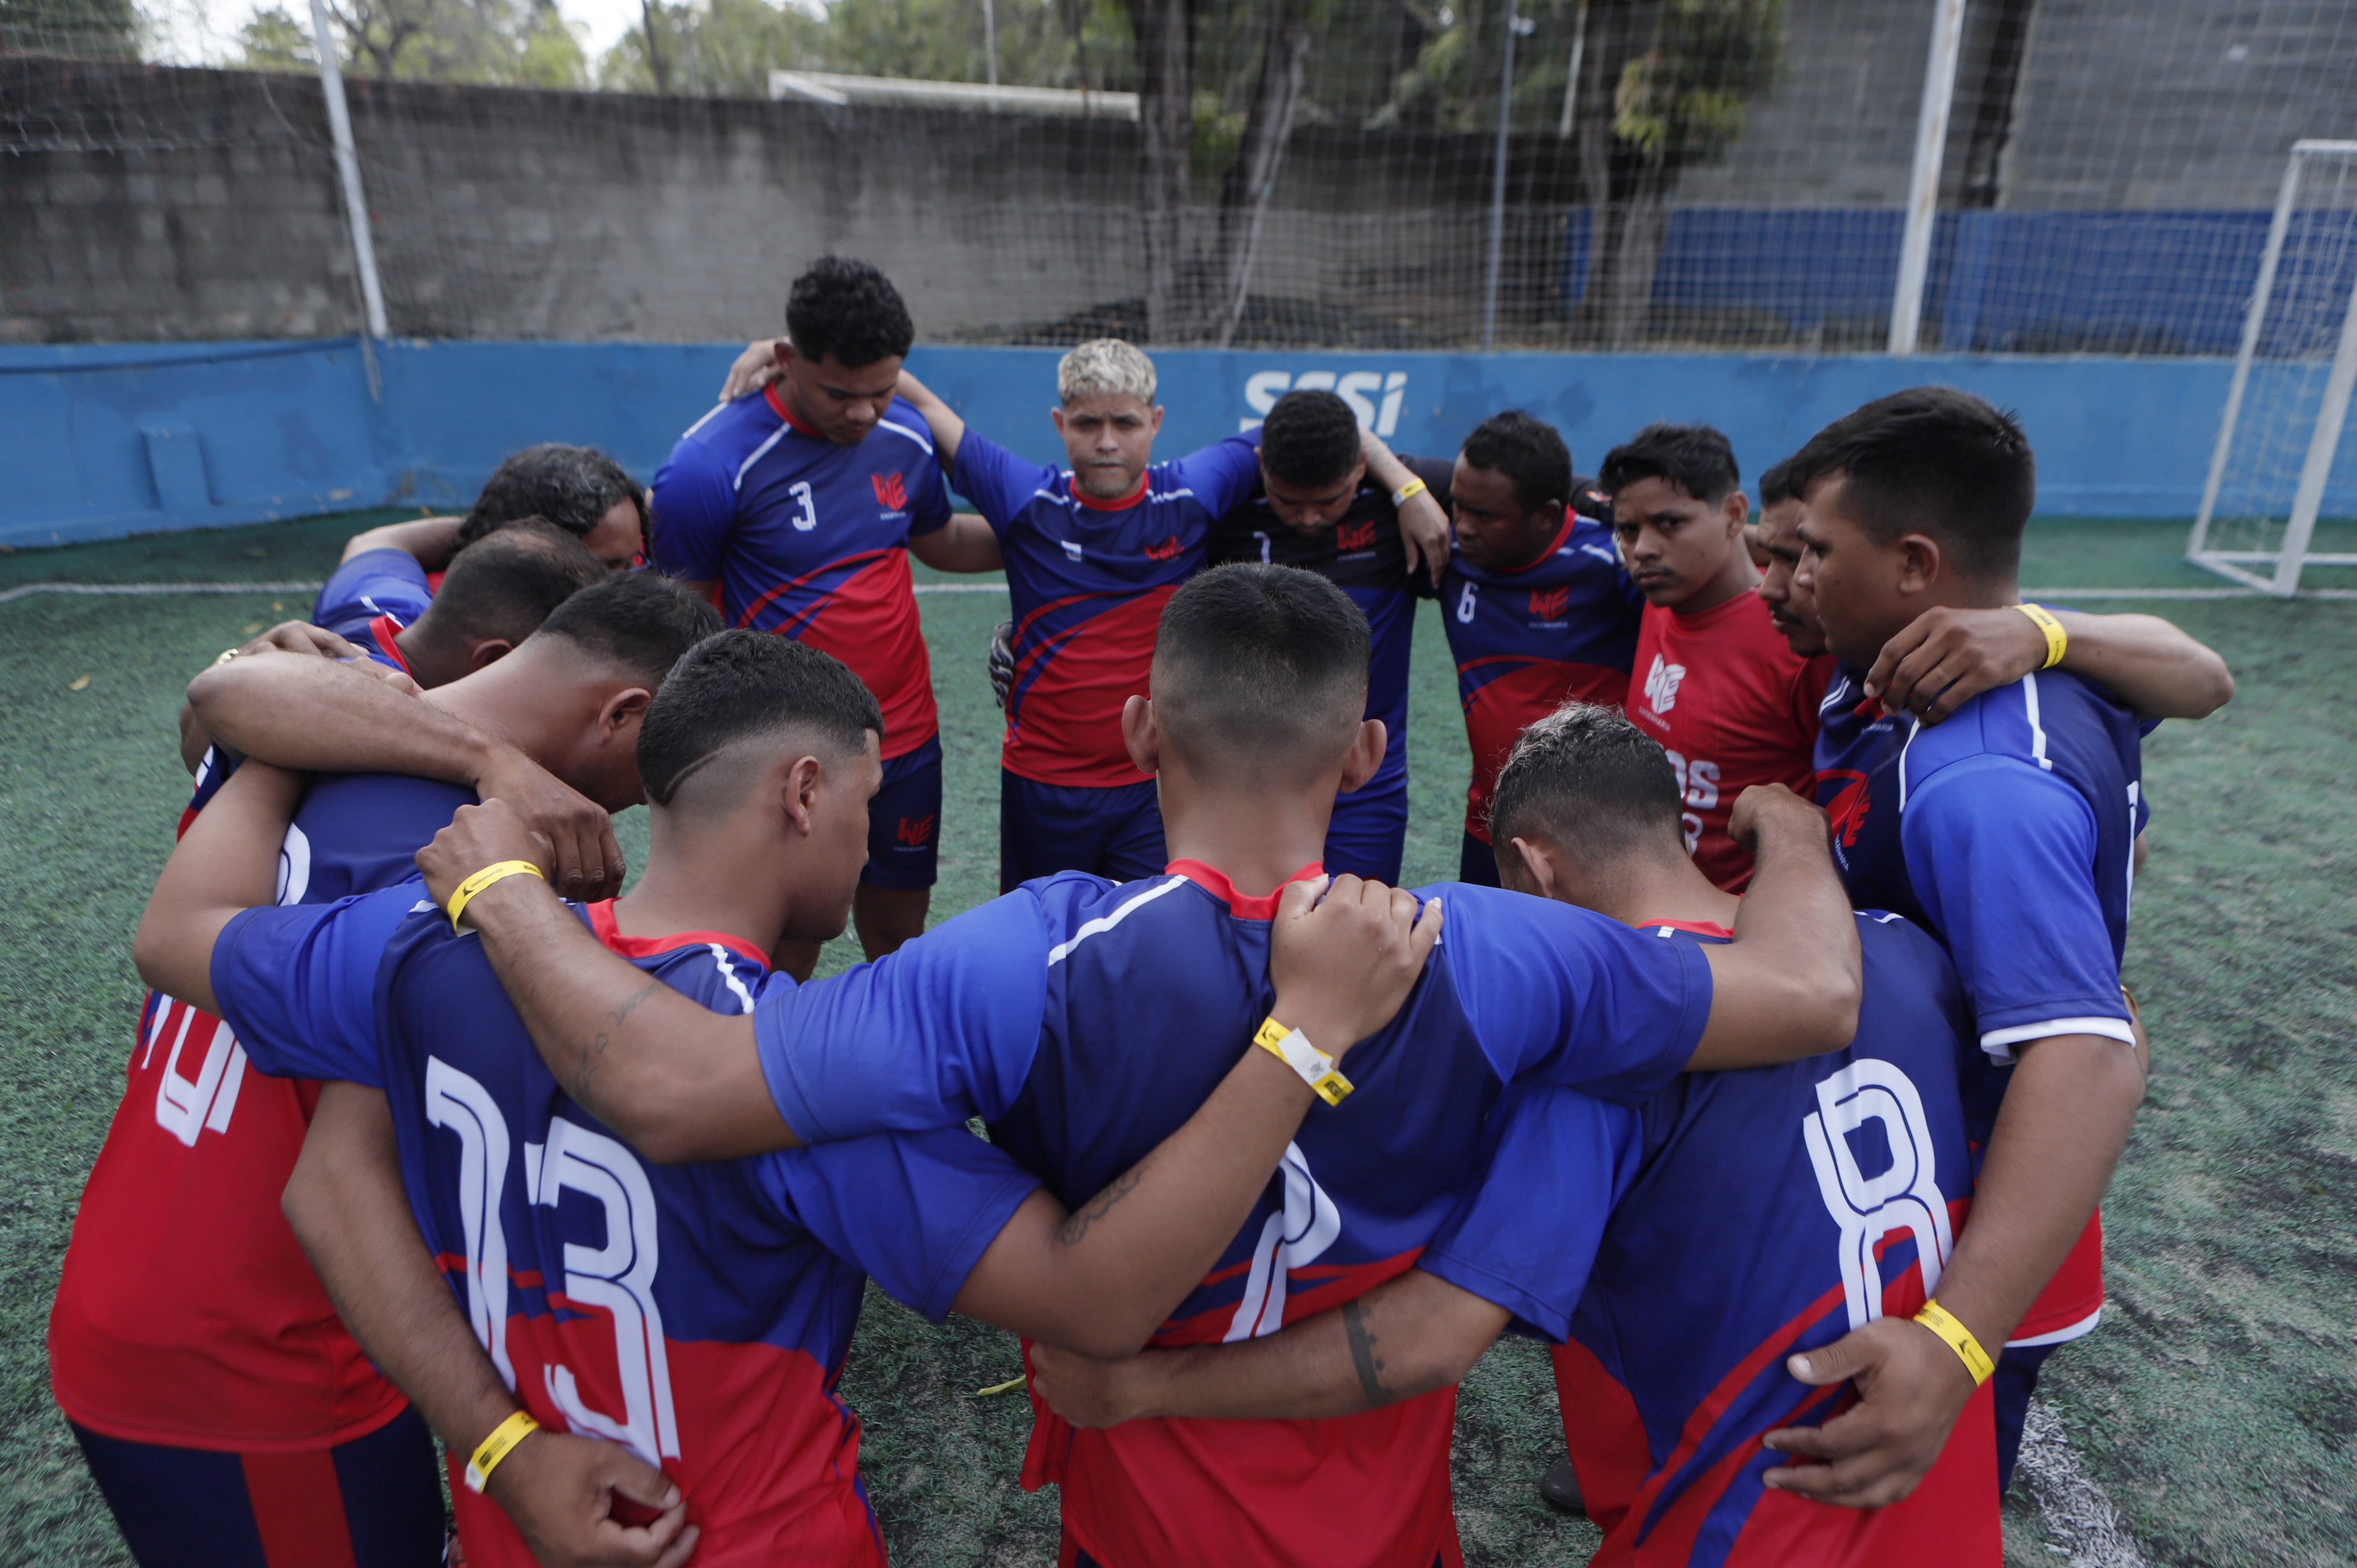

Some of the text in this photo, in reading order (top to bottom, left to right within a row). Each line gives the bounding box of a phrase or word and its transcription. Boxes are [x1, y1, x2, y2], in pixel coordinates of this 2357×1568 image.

[789, 481, 817, 531] 3
[1457, 581, 1480, 623] 6
[1638, 705, 1671, 733] ENGENHARIA
[1802, 1058, 1954, 1332] 8
[425, 1054, 681, 1472] 13
